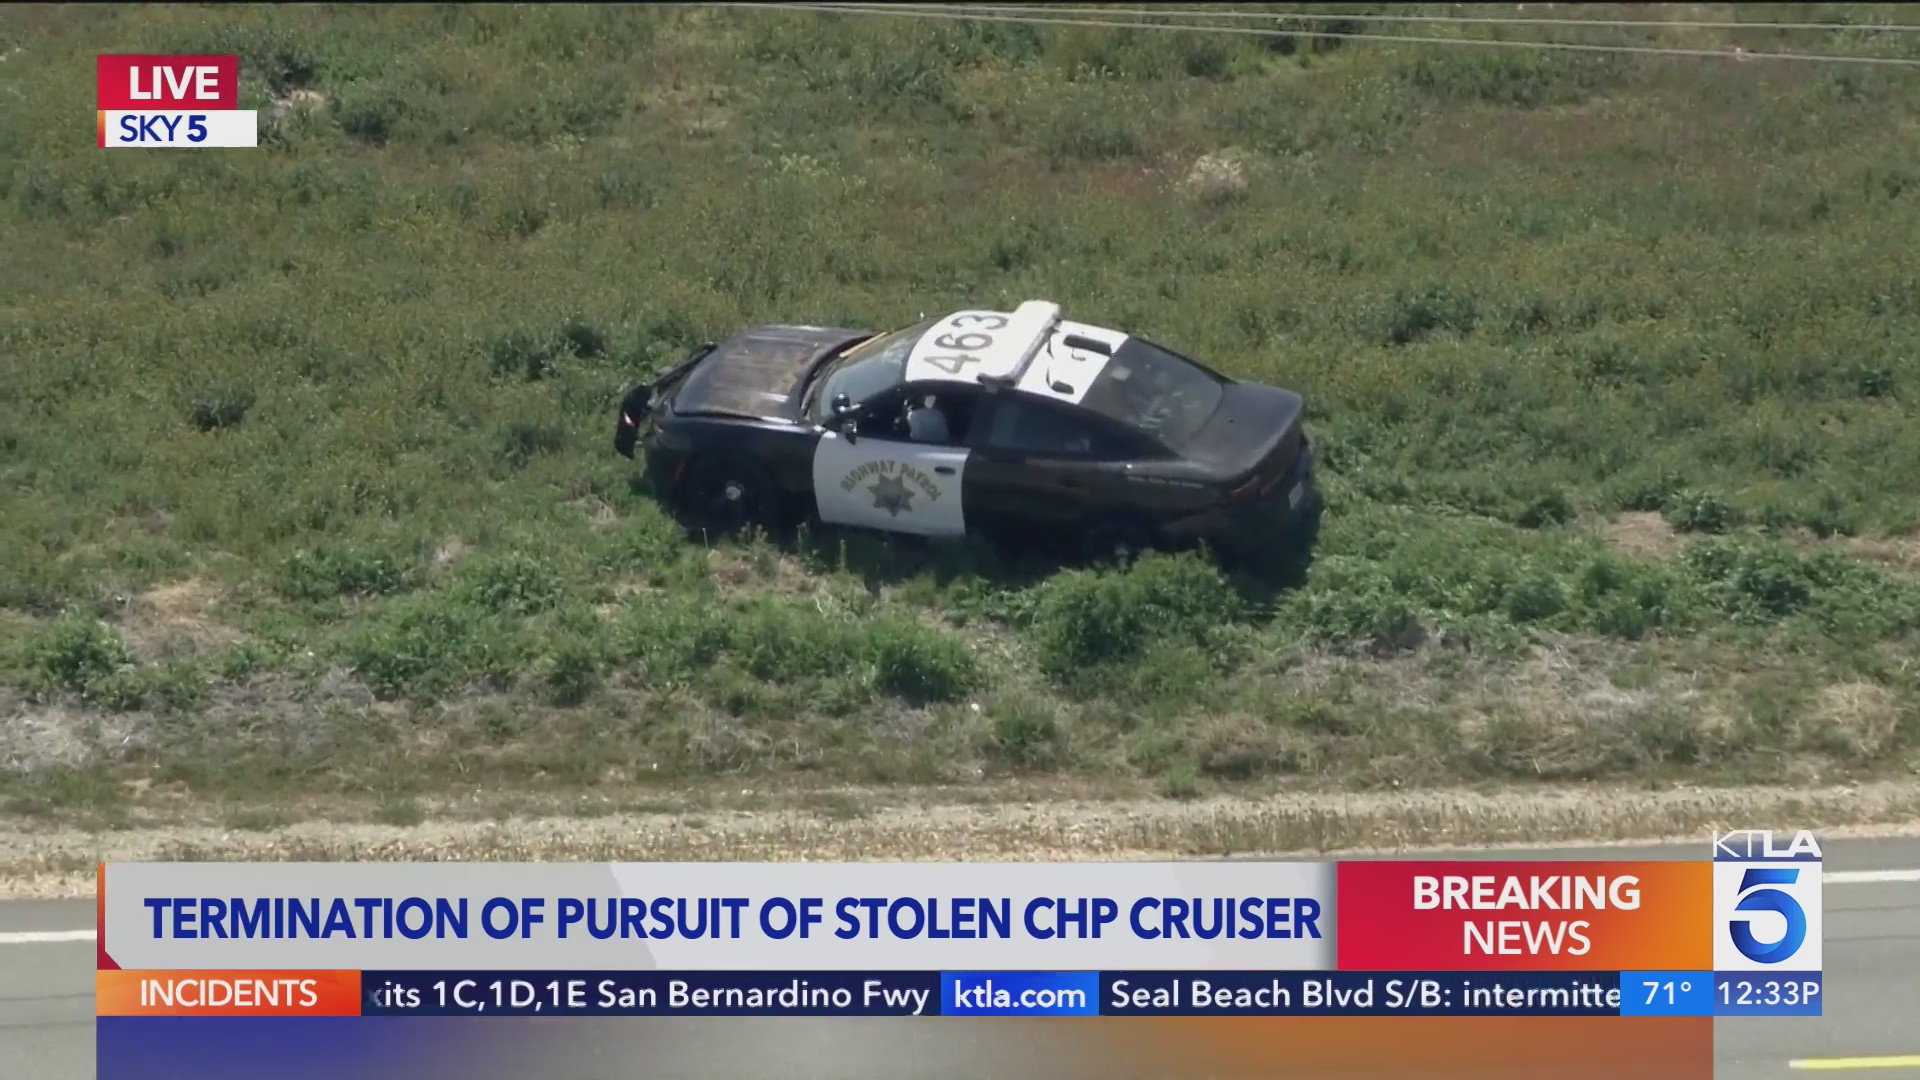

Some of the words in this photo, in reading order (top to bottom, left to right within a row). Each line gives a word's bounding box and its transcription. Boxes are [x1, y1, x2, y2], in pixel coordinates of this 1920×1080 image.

[923, 315, 1009, 374] 463
[840, 460, 896, 493] HIGHWAY
[901, 463, 942, 501] PATROL
